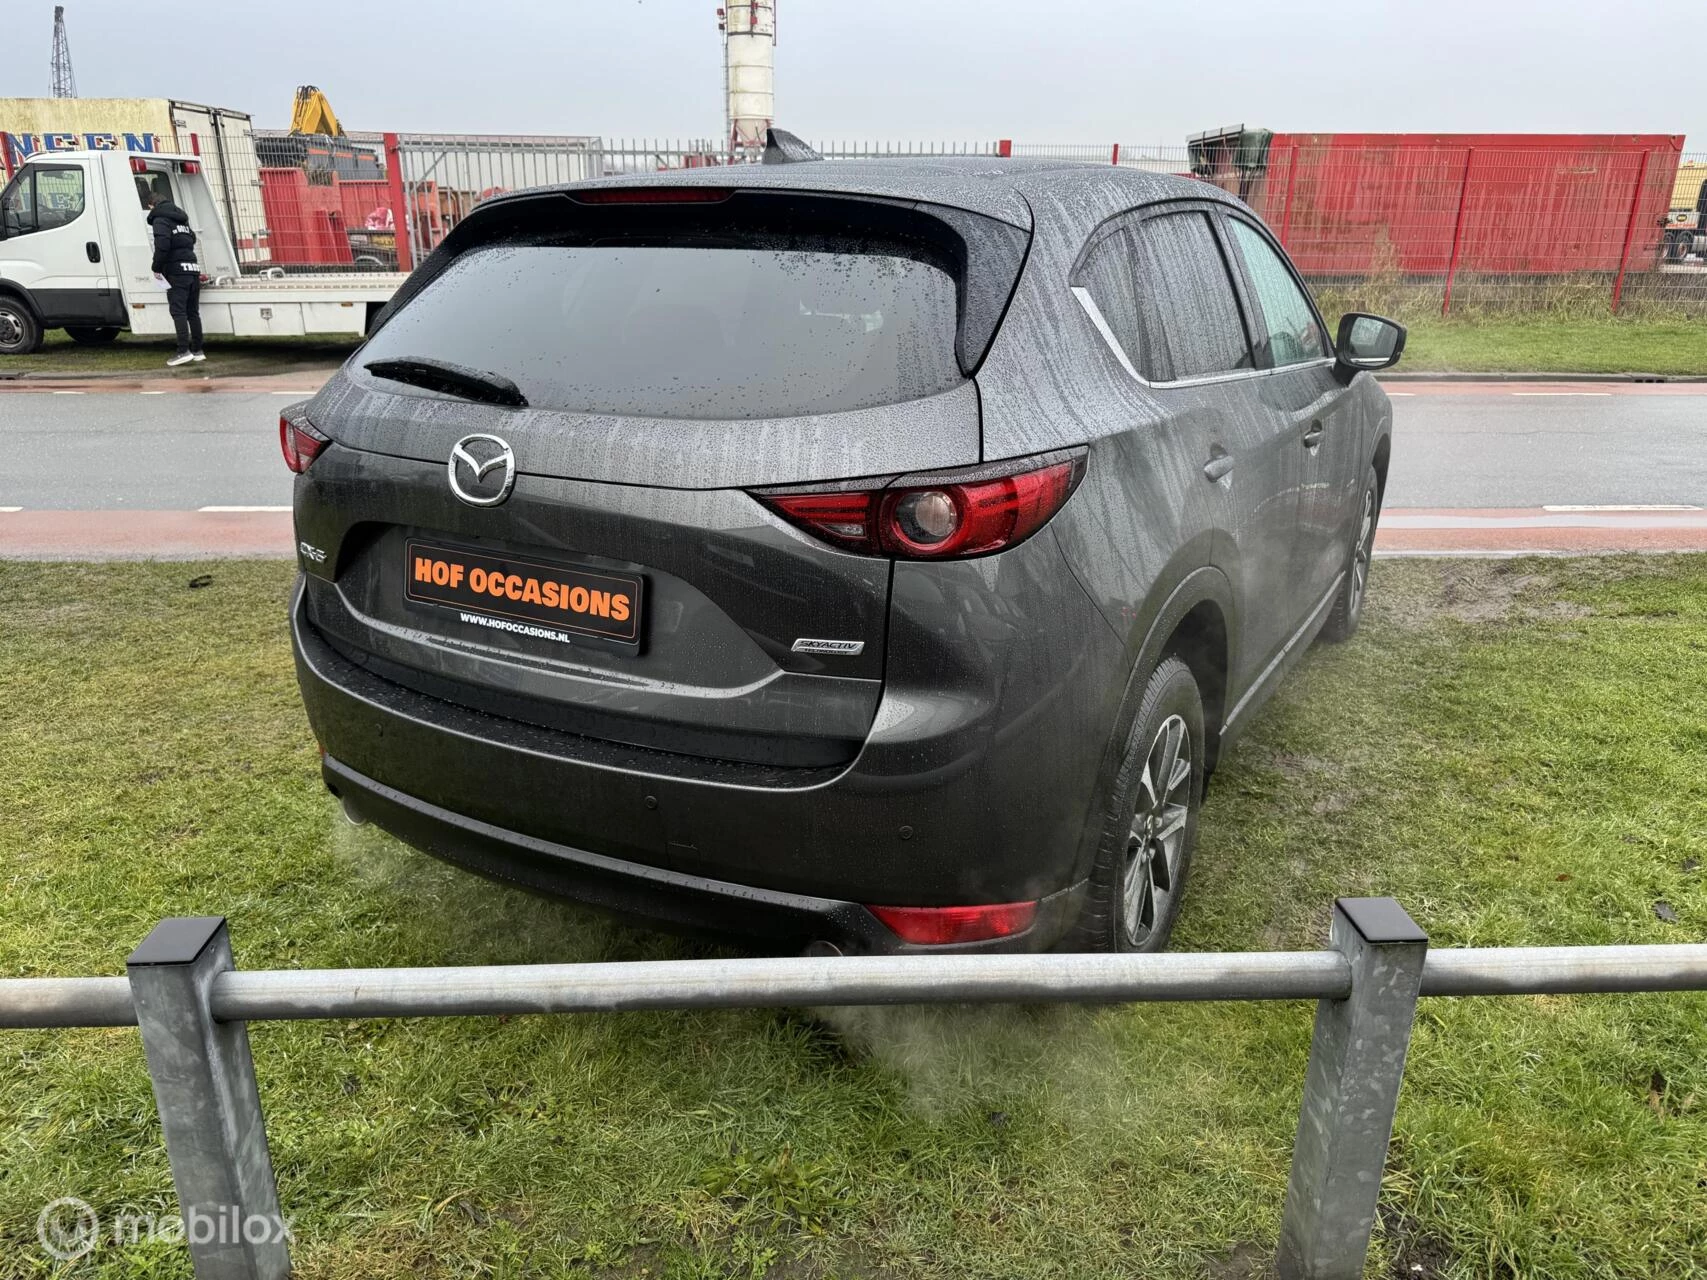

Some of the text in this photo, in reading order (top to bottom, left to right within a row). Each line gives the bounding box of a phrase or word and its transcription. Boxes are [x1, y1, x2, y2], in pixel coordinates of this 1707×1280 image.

[415, 557, 630, 621] HOF OCCASIONS
[460, 612, 570, 643] WWW.HOFOCCASIONS.NL
[800, 640, 857, 649] SKYACTIV
